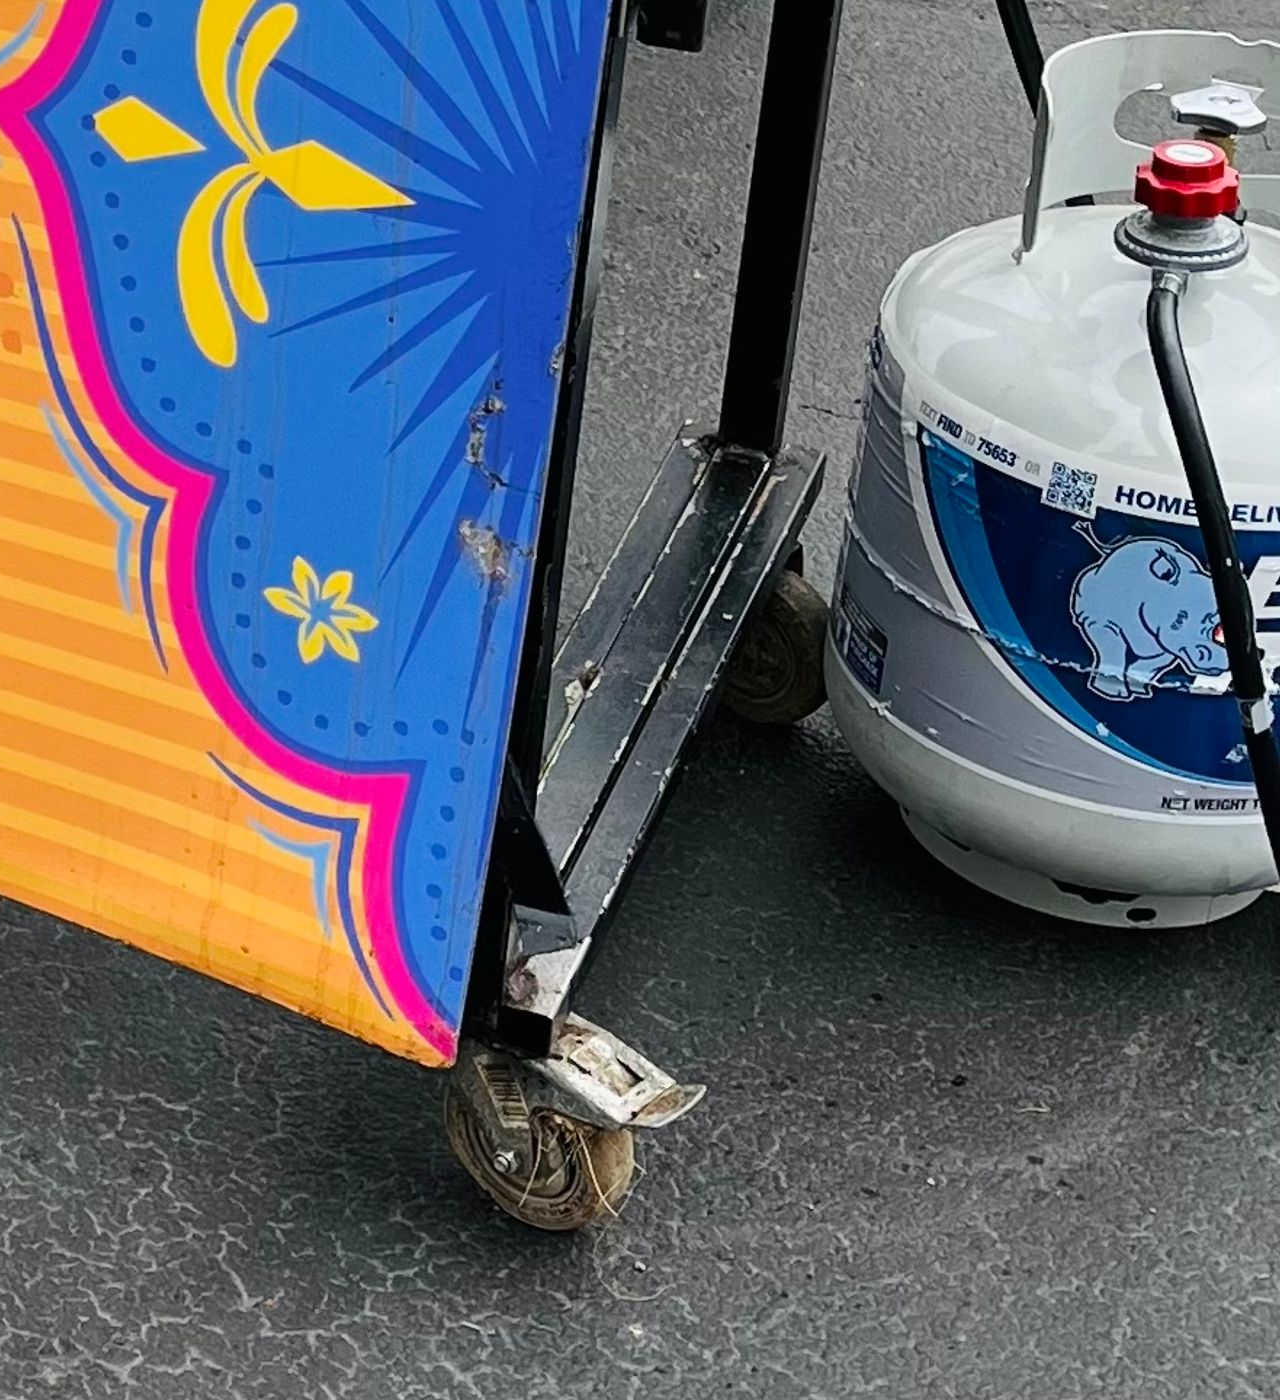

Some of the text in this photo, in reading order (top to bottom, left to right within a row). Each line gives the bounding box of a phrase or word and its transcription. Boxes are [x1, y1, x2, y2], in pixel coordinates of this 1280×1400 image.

[977, 436, 1017, 468] 75653
[1115, 485, 1280, 523] HOME ELI
[1160, 796, 1191, 811] NET
[1193, 798, 1249, 811] WEIGHT
